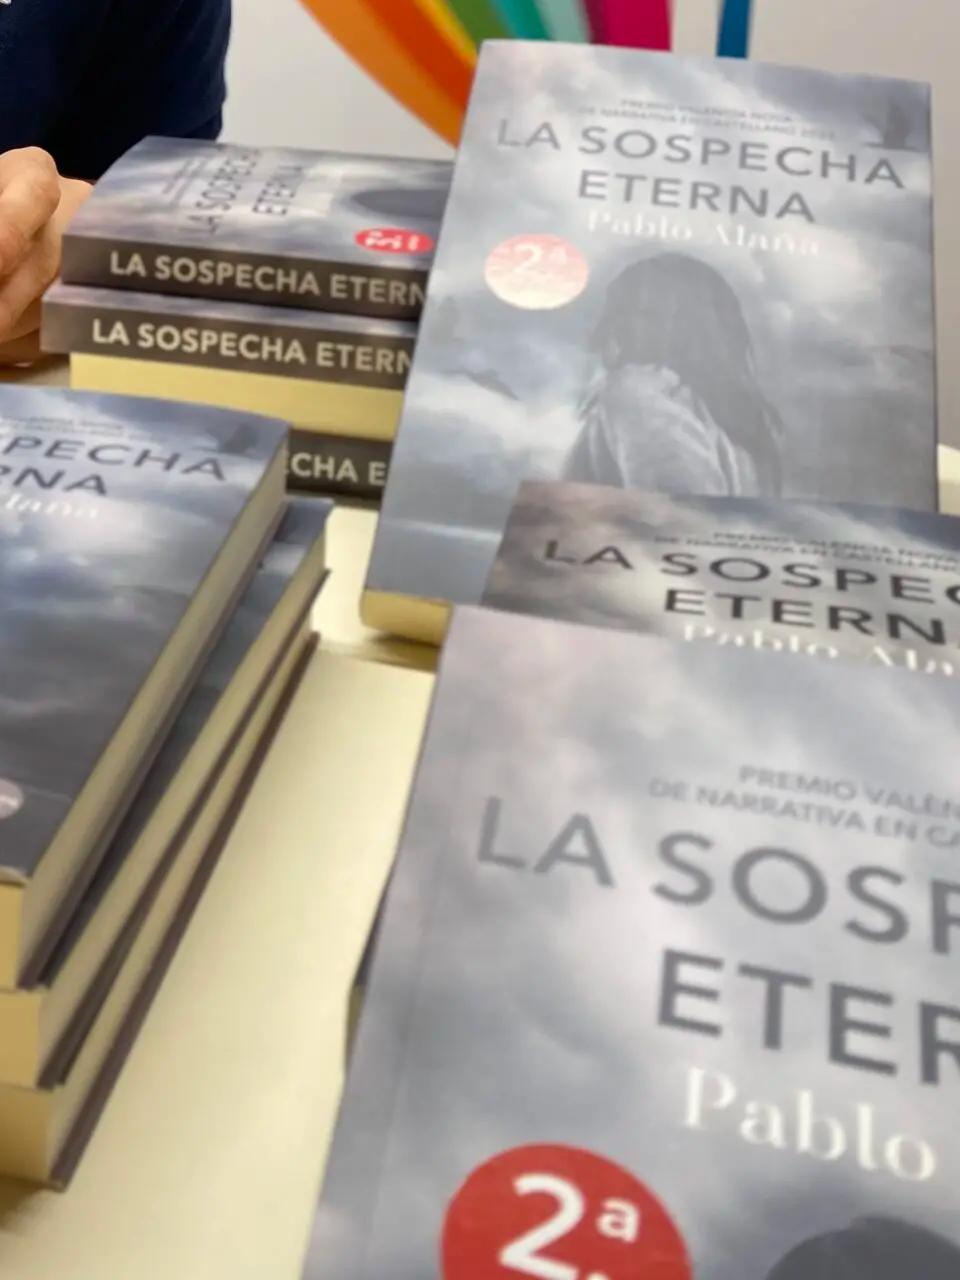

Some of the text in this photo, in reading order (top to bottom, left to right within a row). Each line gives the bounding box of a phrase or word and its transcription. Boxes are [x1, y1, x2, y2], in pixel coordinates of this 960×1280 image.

[497, 118, 561, 150] LA
[577, 126, 905, 189] SOSPECHA
[577, 169, 816, 223] ETERNA
[587, 210, 693, 241] Pablo
[110, 250, 426, 307] LA SOSPECHA ETERN
[92, 319, 412, 375] LA SOSPECHA ETERN
[286, 452, 386, 487] CHA E
[543, 539, 634, 571] LA
[664, 587, 960, 646] ETERN
[648, 777, 688, 803] DE
[739, 765, 858, 802] PREMIO
[476, 796, 960, 956] LA SOSP
[656, 947, 960, 1087] ETER
[684, 1065, 936, 1182] Pablo
